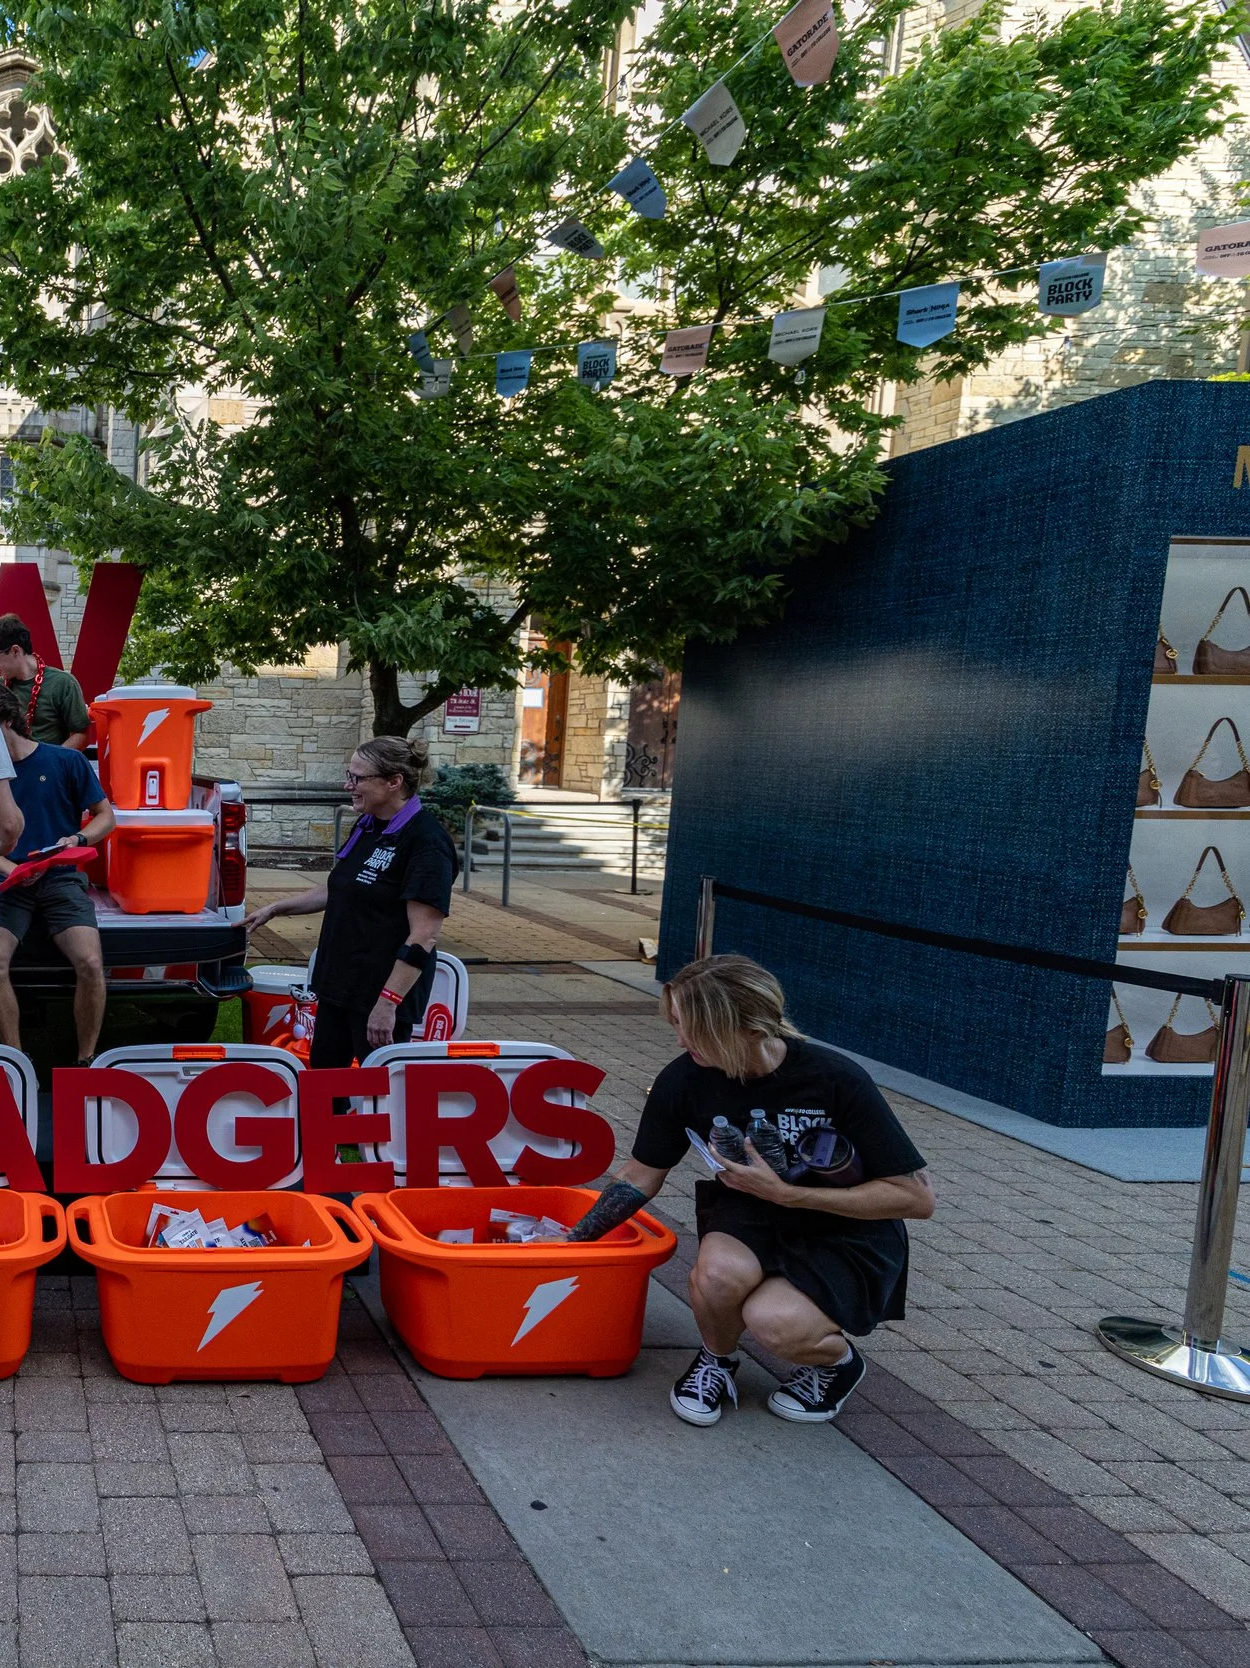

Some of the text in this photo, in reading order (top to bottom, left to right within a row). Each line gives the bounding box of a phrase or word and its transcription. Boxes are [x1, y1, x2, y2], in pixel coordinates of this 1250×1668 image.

[787, 11, 829, 57] GATORADE
[1048, 278, 1093, 295] BLOCK
[1046, 290, 1092, 306] PARTY
[667, 343, 705, 352] GATORADE
[583, 358, 610, 369] BLOCK
[582, 367, 609, 379] PARTY
[371, 847, 396, 862] BLOCK
[363, 857, 390, 871] PARTY
[777, 1113, 832, 1131] BLOCK
[179, 1229, 198, 1245] TAILGATE
